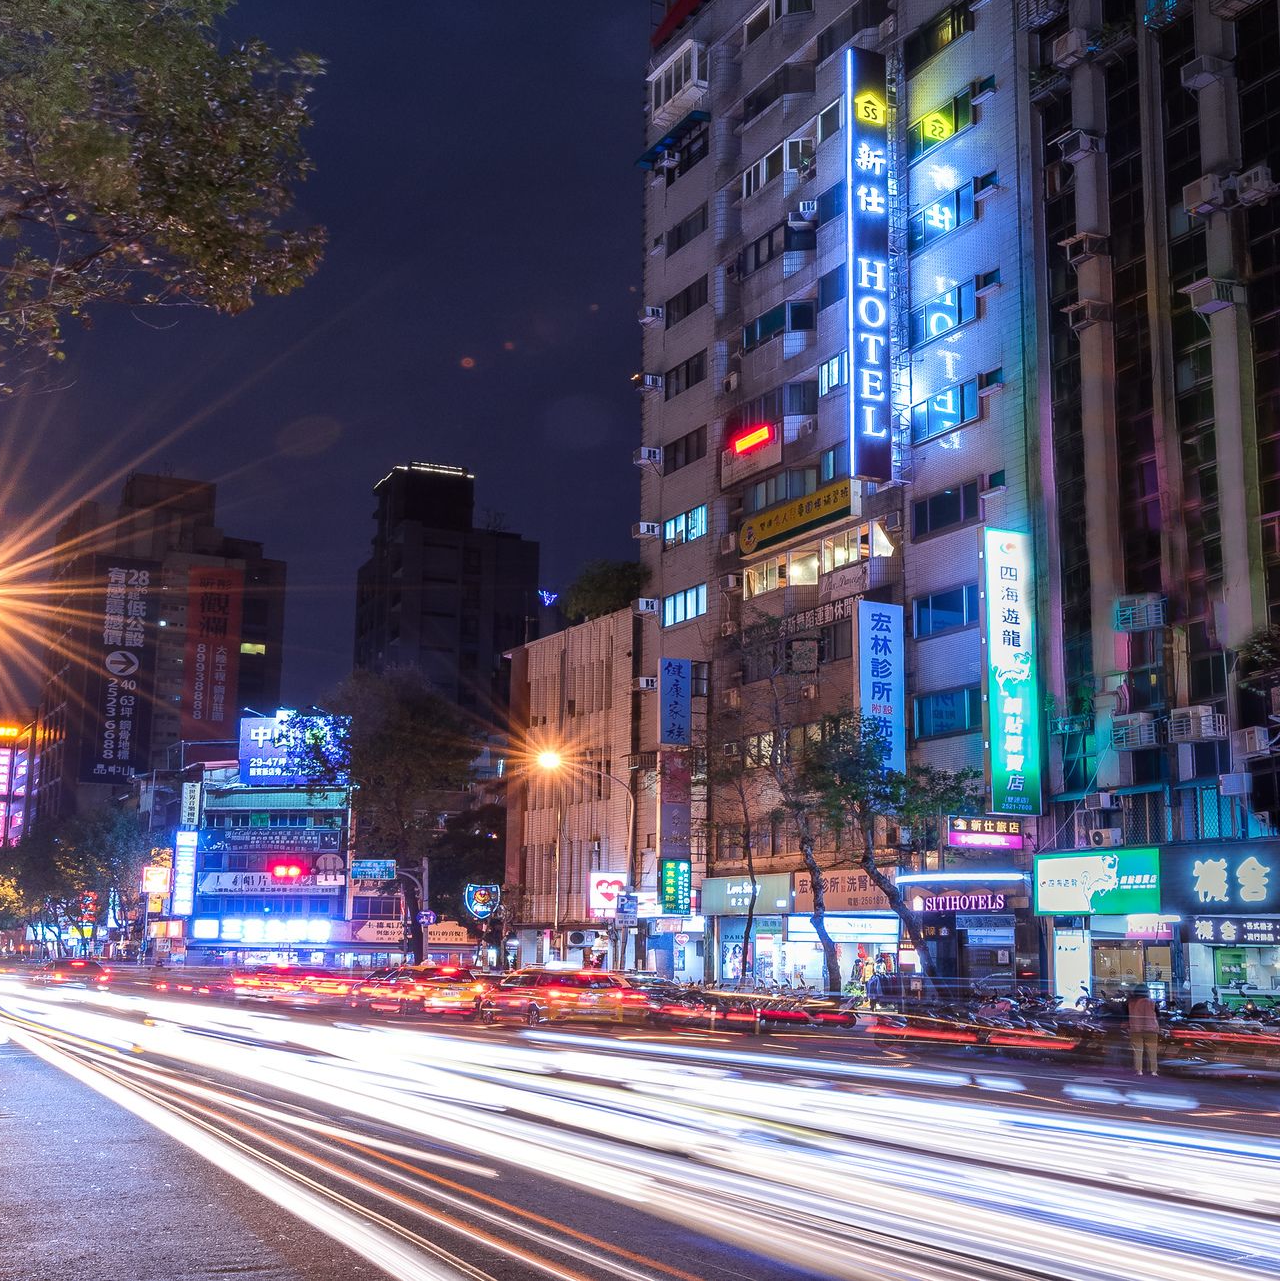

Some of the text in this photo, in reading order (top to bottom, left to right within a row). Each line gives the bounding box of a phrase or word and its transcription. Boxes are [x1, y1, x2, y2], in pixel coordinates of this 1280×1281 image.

[854, 141, 887, 215] 新仕
[857, 257, 887, 438] HOTEL
[1000, 565, 1022, 648] 四海遊龍
[121, 680, 137, 691] 40
[192, 644, 206, 720] 89938888
[870, 612, 893, 703] 宏林診所
[664, 661, 686, 741] 健康家族
[971, 820, 1020, 833] 新仕旅店
[726, 882, 743, 896] Love
[925, 894, 1005, 912] SITIHOTELS
